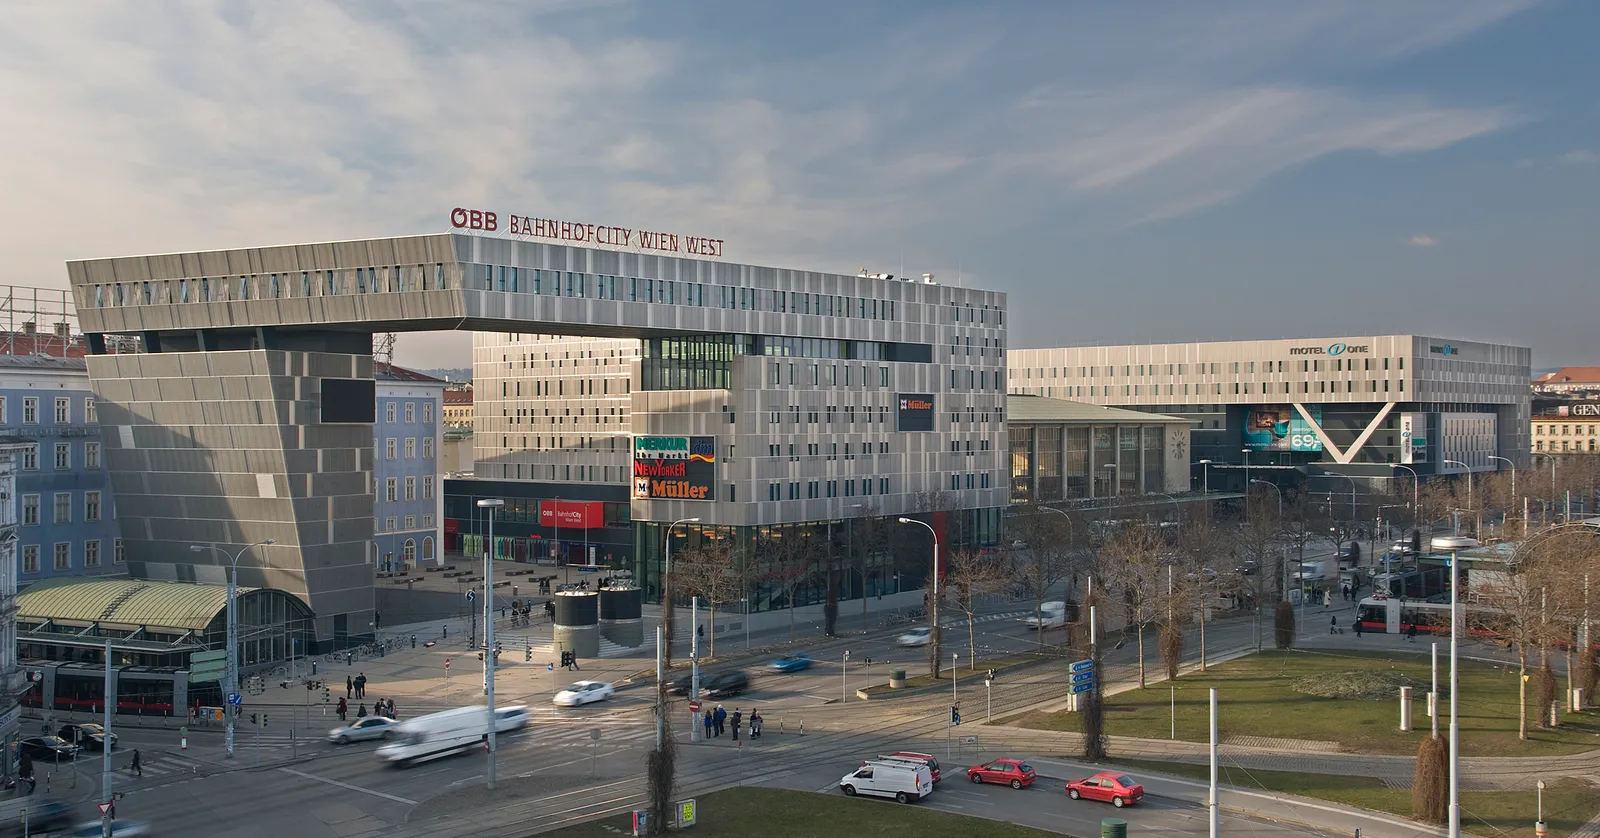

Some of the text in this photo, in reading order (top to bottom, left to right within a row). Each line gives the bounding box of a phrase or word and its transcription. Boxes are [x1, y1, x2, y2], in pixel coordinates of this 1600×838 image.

[451, 207, 724, 257] ÖBB BAHNHOFCITY WIEN WEST
[1347, 345, 1369, 354] ONE
[908, 400, 932, 410] Müller
[636, 437, 689, 451] MERKUR
[693, 440, 713, 455] dm
[651, 480, 709, 499] Müller
